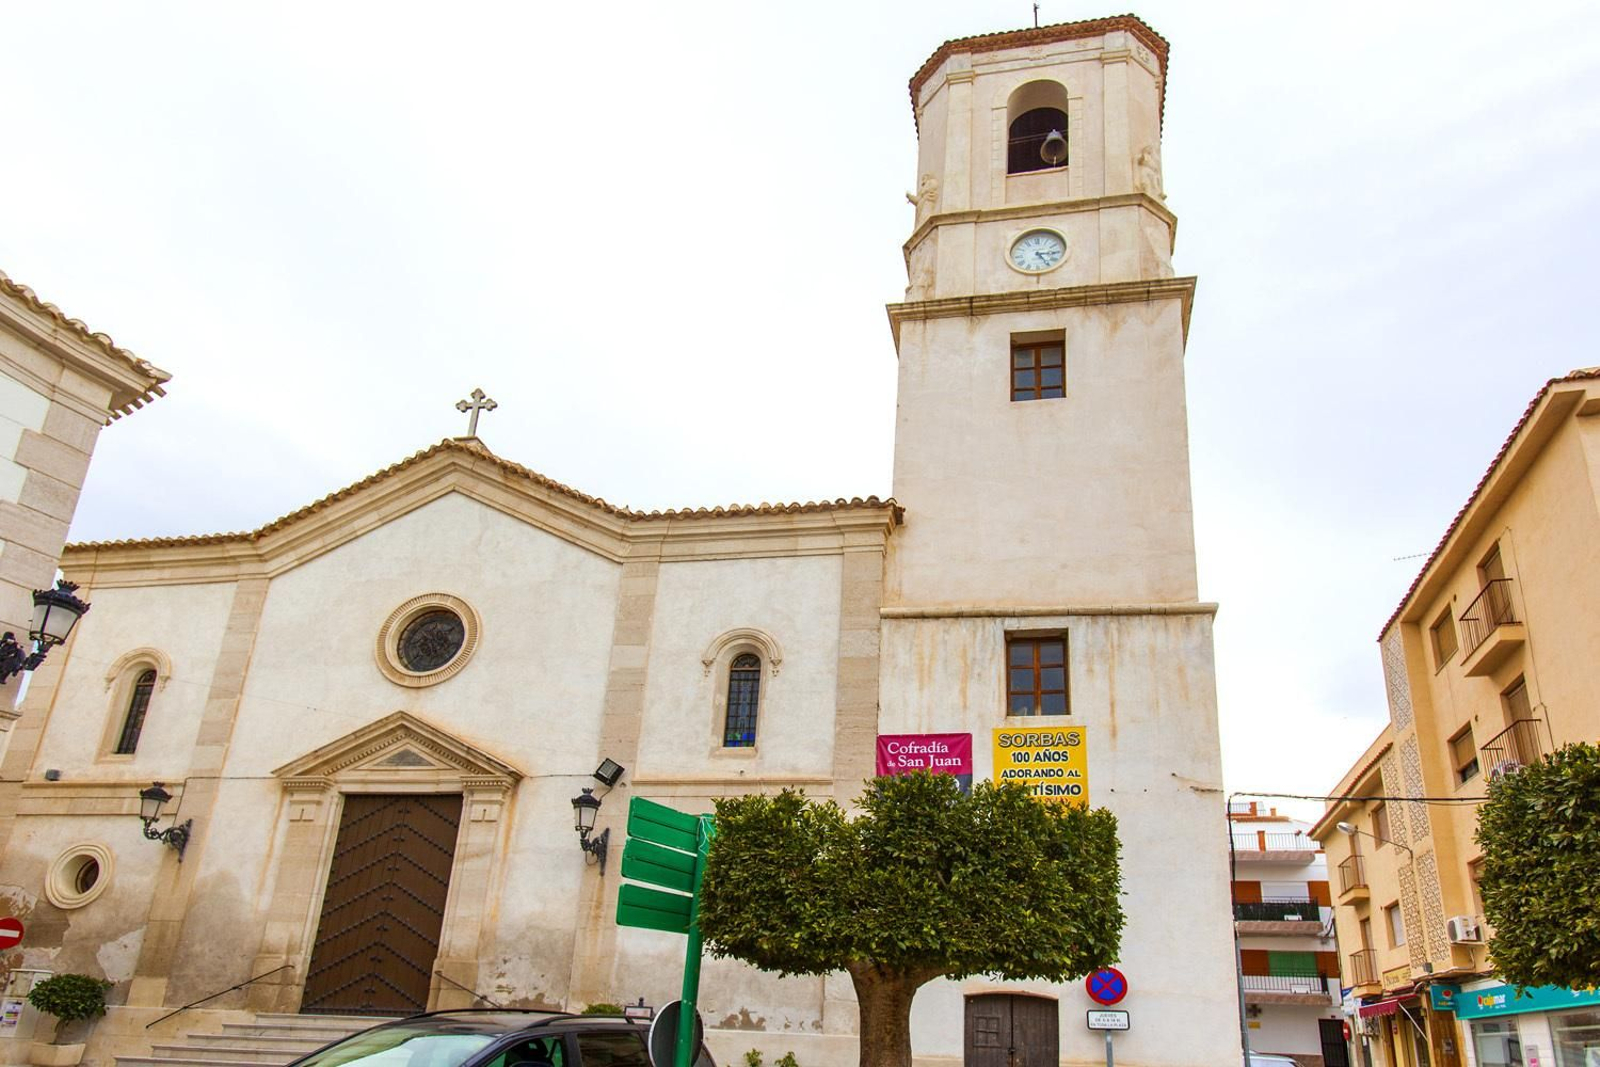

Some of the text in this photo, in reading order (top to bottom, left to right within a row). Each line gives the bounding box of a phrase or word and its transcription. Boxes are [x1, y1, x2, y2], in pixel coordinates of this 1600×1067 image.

[887, 740, 949, 754] Cofradía
[998, 732, 1080, 748] SORBAS
[898, 755, 925, 767] San
[929, 754, 962, 769] Juan
[1011, 748, 1069, 763] 100 AÑOS
[1001, 768, 1081, 779] ADORANDO AL
